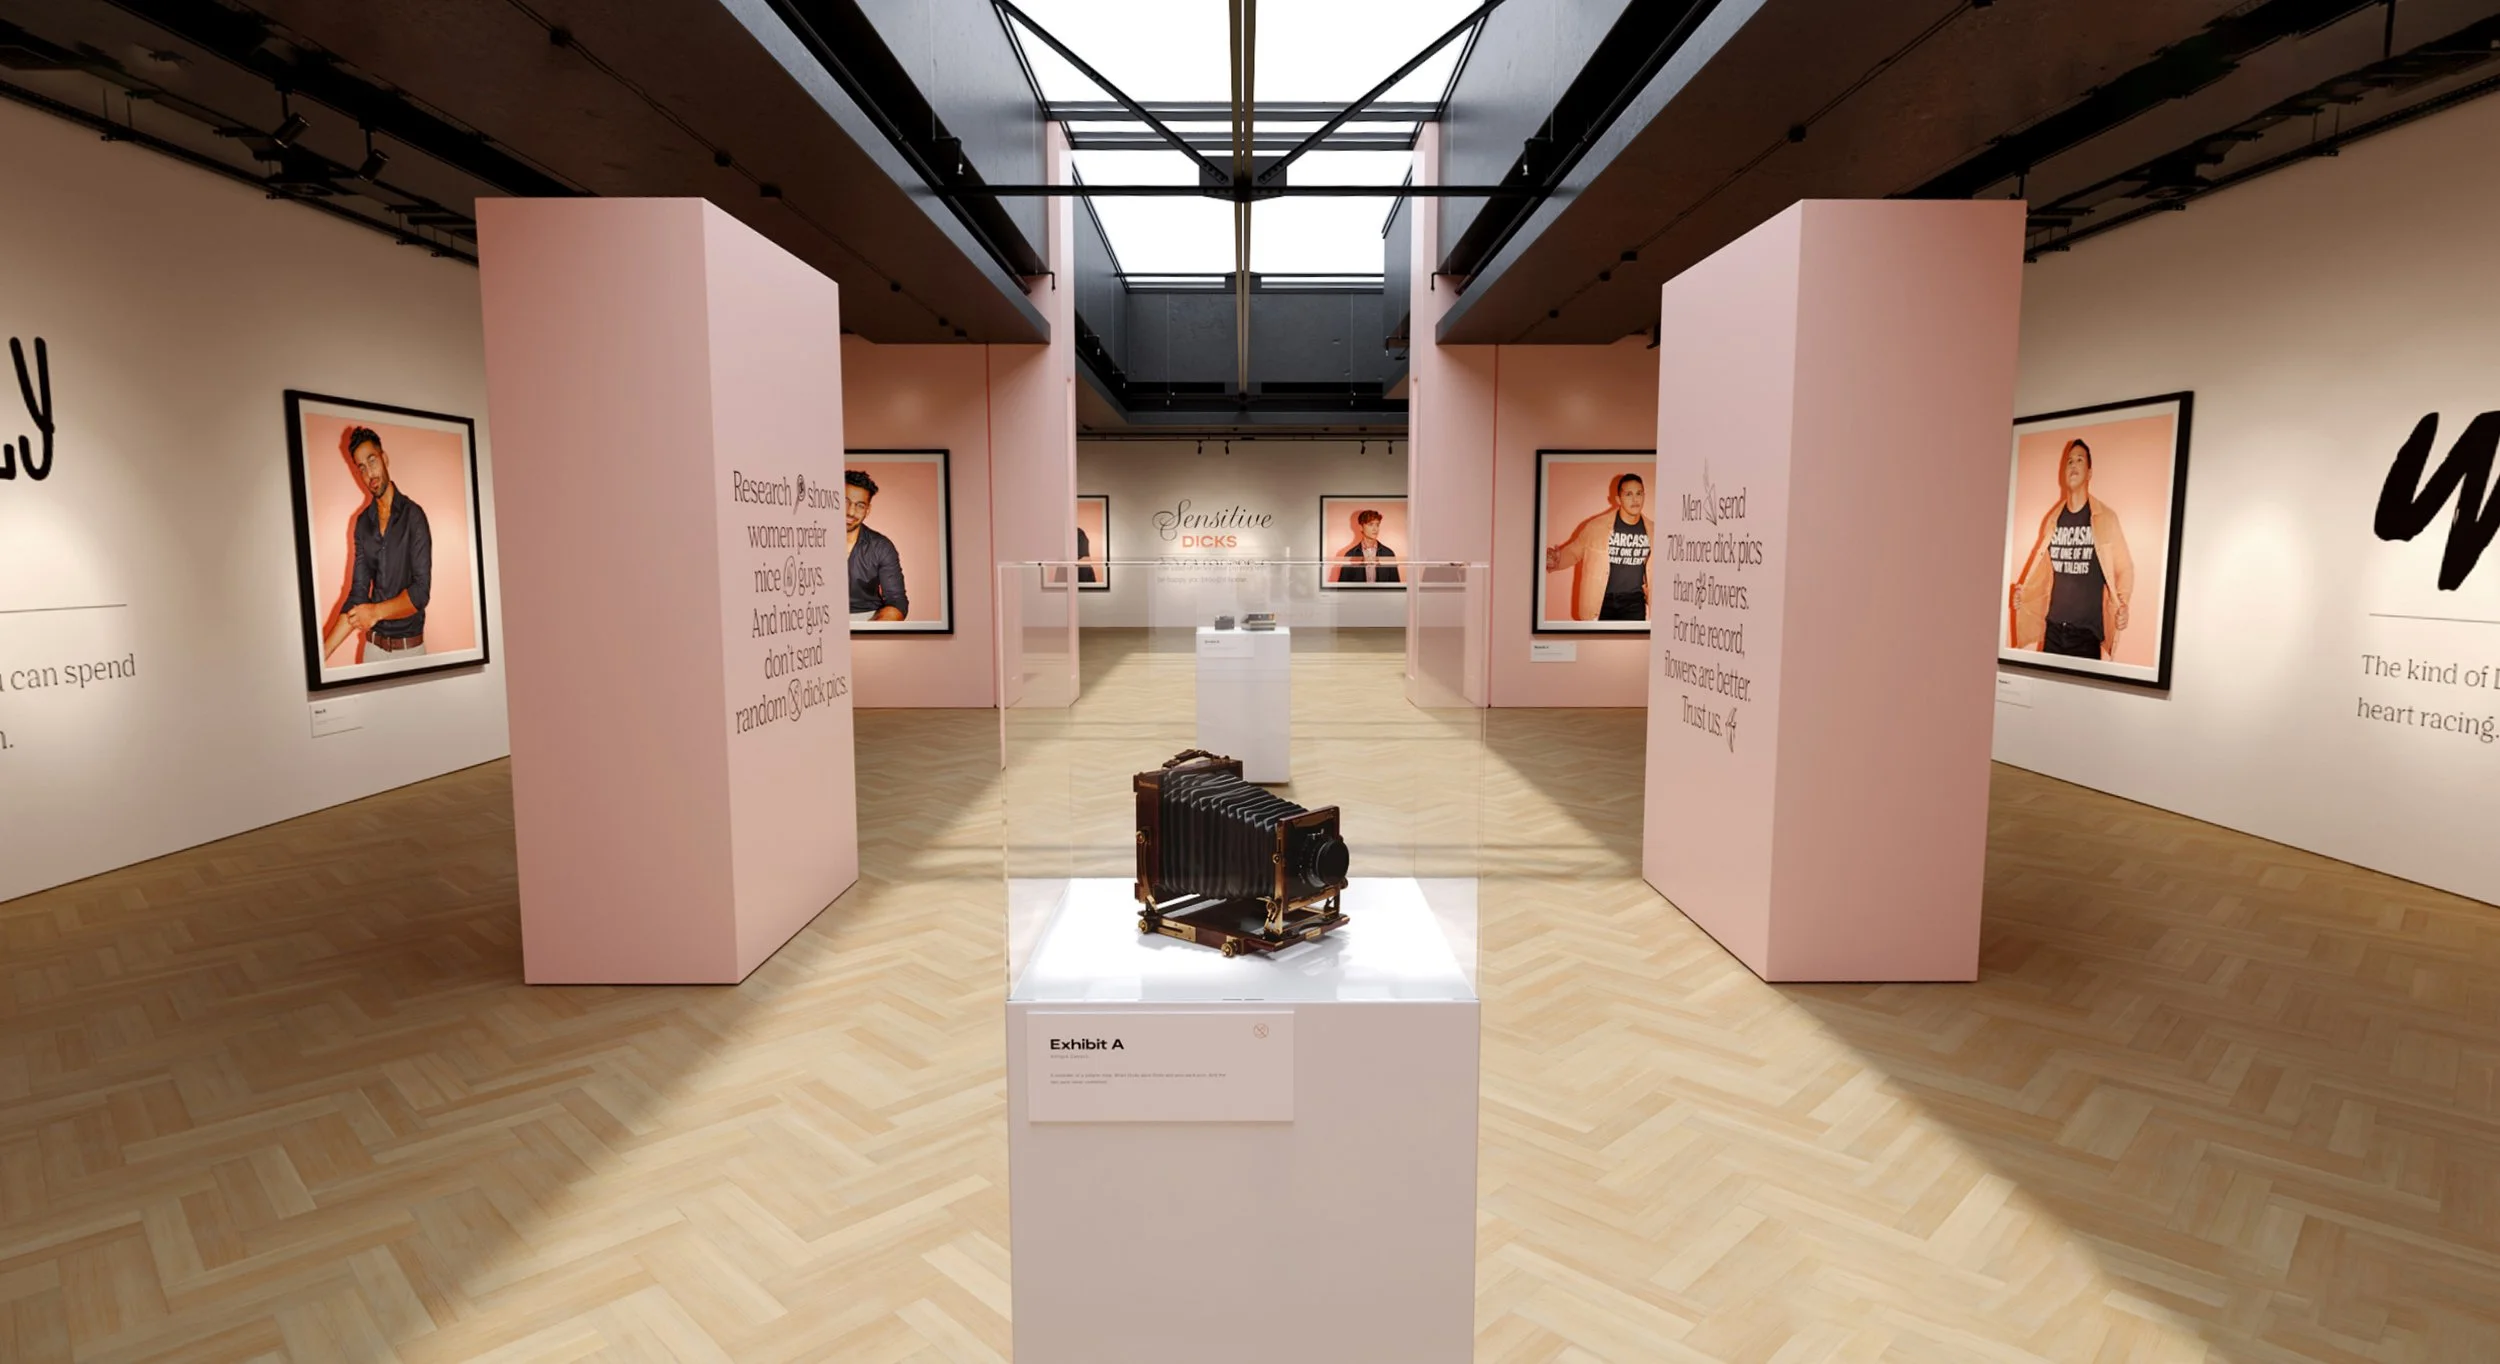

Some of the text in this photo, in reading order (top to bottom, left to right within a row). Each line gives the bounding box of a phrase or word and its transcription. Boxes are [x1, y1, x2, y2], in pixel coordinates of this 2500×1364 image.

[733, 470, 840, 510] Research shows
[1682, 487, 1746, 521] Men send
[748, 520, 827, 554] women prefer
[1152, 499, 1274, 541] Sensitive
[1182, 535, 1238, 548] DICKS
[1667, 533, 1763, 571] 70% more dick pics
[754, 561, 825, 595] nice guys.
[1673, 573, 1749, 610] than flowers.
[752, 601, 830, 638] And nice guys
[1673, 613, 1745, 658] For the record,
[11, 667, 58, 690] can
[64, 653, 136, 689] spend
[764, 637, 823, 679] don't send
[1664, 650, 1751, 702] flowers are better.
[2361, 654, 2402, 678] The
[2407, 658, 2458, 685] kind
[2464, 665, 2490, 688] of
[736, 672, 848, 734] random dick pics.
[1681, 695, 1723, 738] Trust us.
[2357, 697, 2500, 744] heart racing.
[1050, 1038, 1124, 1050] Exhibit A
